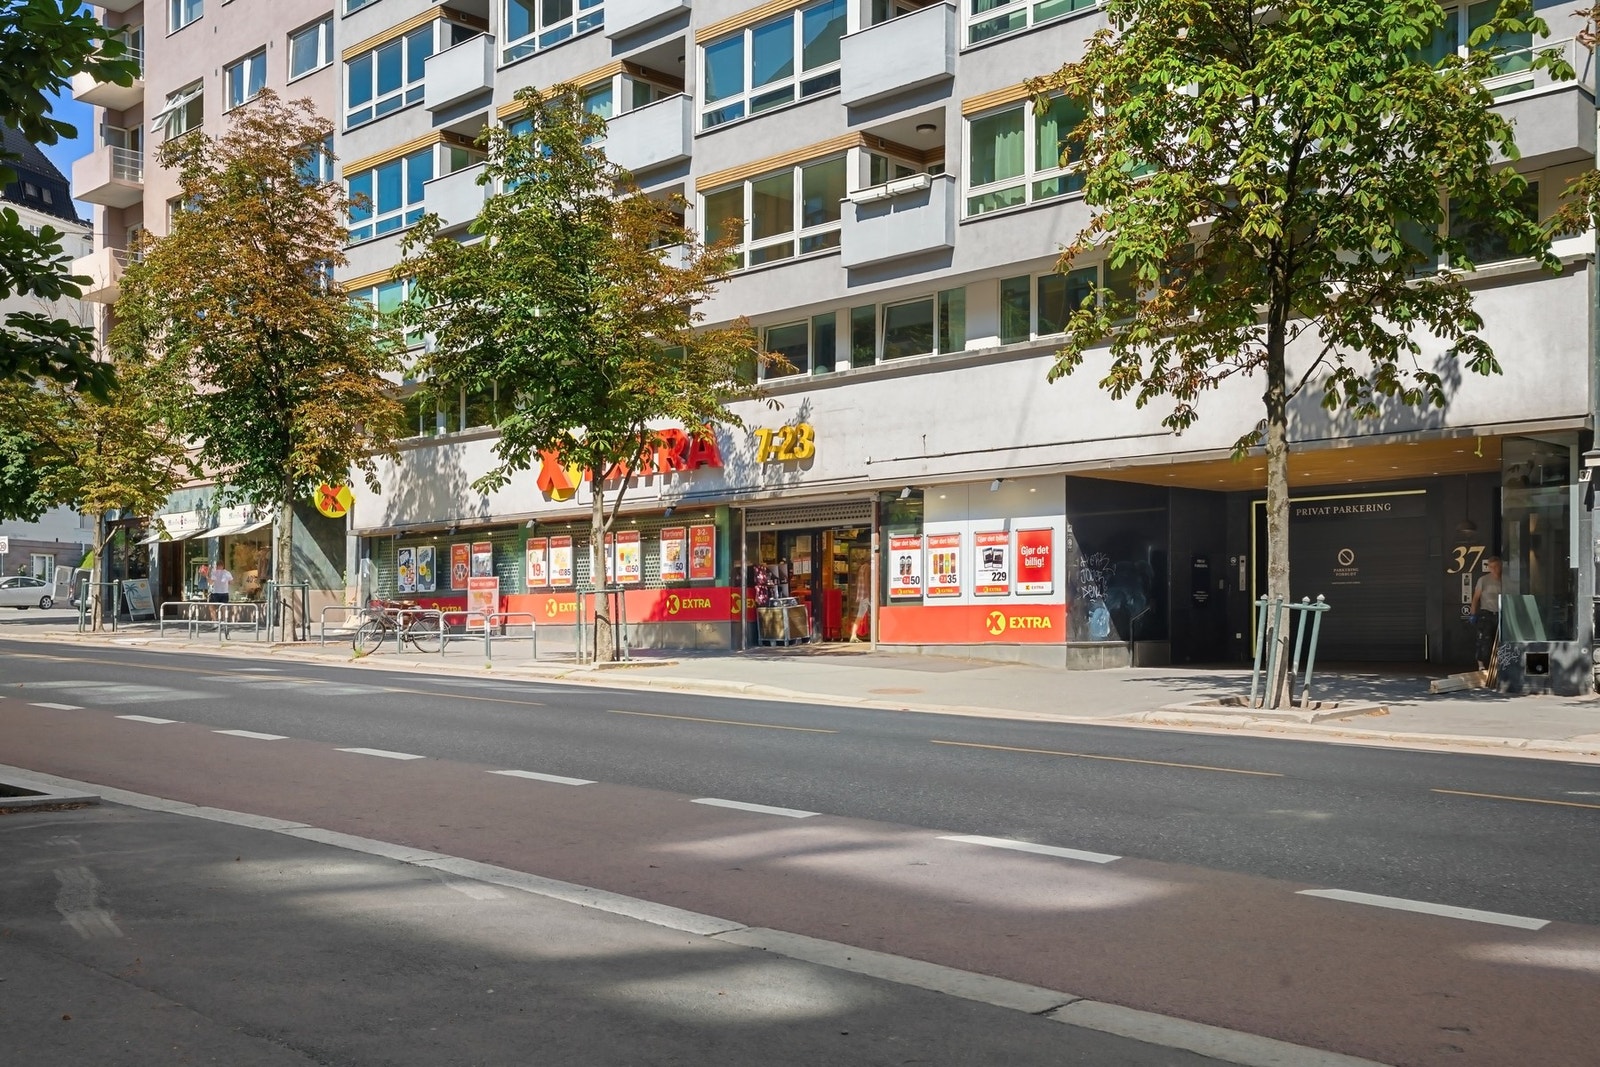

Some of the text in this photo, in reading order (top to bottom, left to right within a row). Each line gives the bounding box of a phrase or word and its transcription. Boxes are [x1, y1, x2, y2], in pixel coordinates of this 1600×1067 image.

[754, 423, 815, 462] 7-23
[584, 423, 724, 481] XTRA
[1581, 471, 1590, 480] 37
[1296, 503, 1392, 516] PRIVAT PARKERING
[1021, 545, 1049, 557] Gjør det
[1024, 556, 1045, 568] billig!
[1447, 546, 1485, 574] 37
[631, 564, 639, 573] 50
[675, 562, 684, 571] 50
[910, 575, 921, 585] 50
[947, 574, 957, 584] 35
[992, 571, 1007, 582] 229
[682, 599, 711, 609] EXTRA
[1009, 616, 1052, 629] EXTRA
